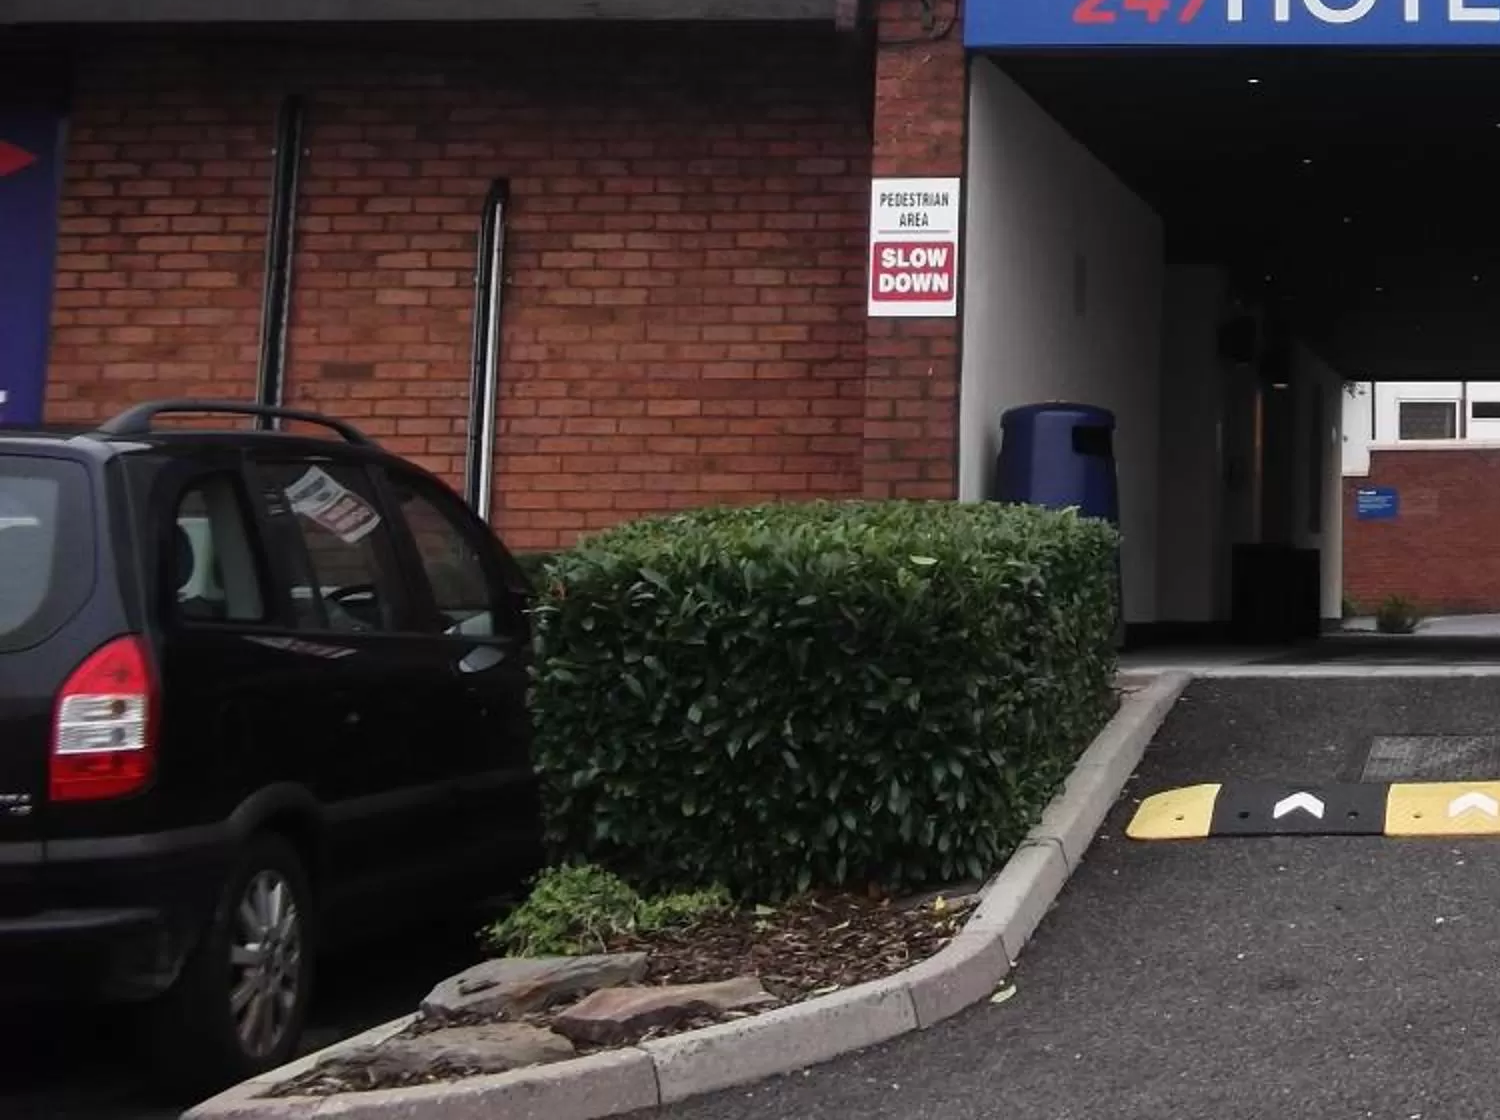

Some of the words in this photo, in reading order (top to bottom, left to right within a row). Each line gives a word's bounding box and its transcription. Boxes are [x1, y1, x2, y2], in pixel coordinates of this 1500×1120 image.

[879, 191, 949, 208] PEDESTRIAN
[899, 212, 929, 227] AREA
[881, 247, 949, 269] SLOW
[878, 272, 950, 294] DOWN
